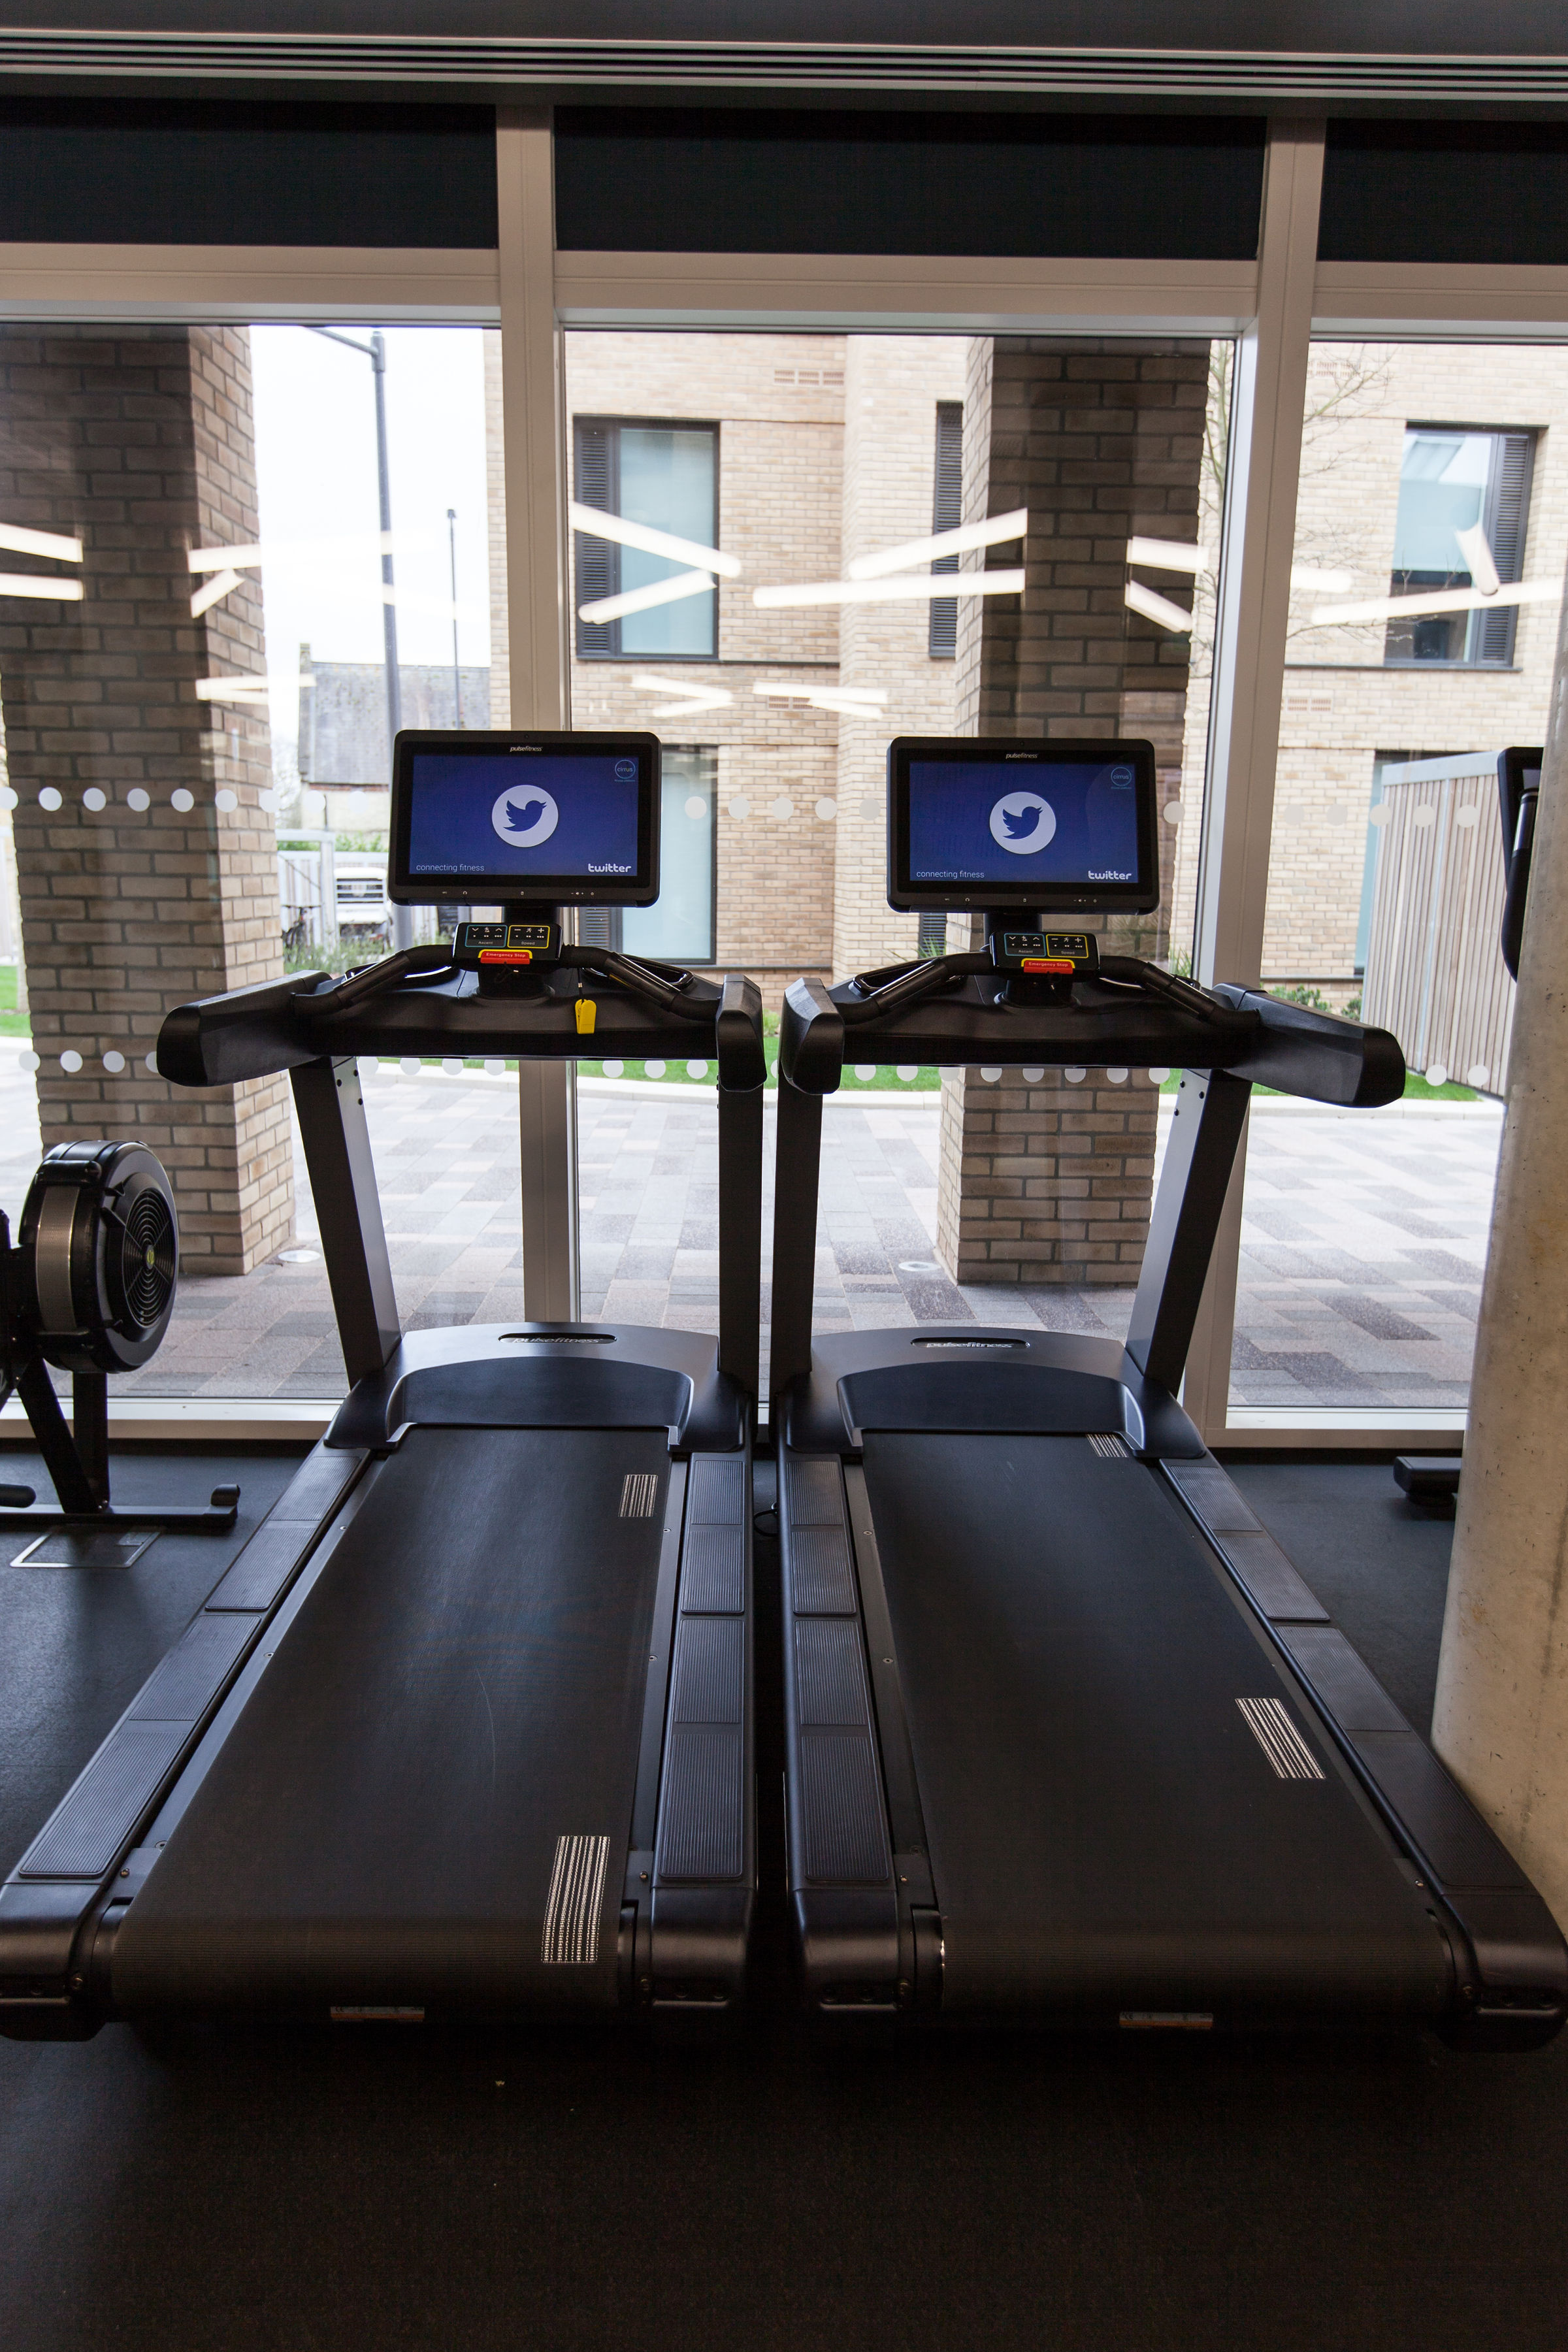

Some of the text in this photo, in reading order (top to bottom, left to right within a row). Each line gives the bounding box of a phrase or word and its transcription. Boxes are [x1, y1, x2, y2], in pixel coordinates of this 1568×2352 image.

[416, 864, 457, 872] connecting
[588, 863, 632, 873] twitter
[916, 870, 958, 879] connecting
[1088, 870, 1132, 880] twitter
